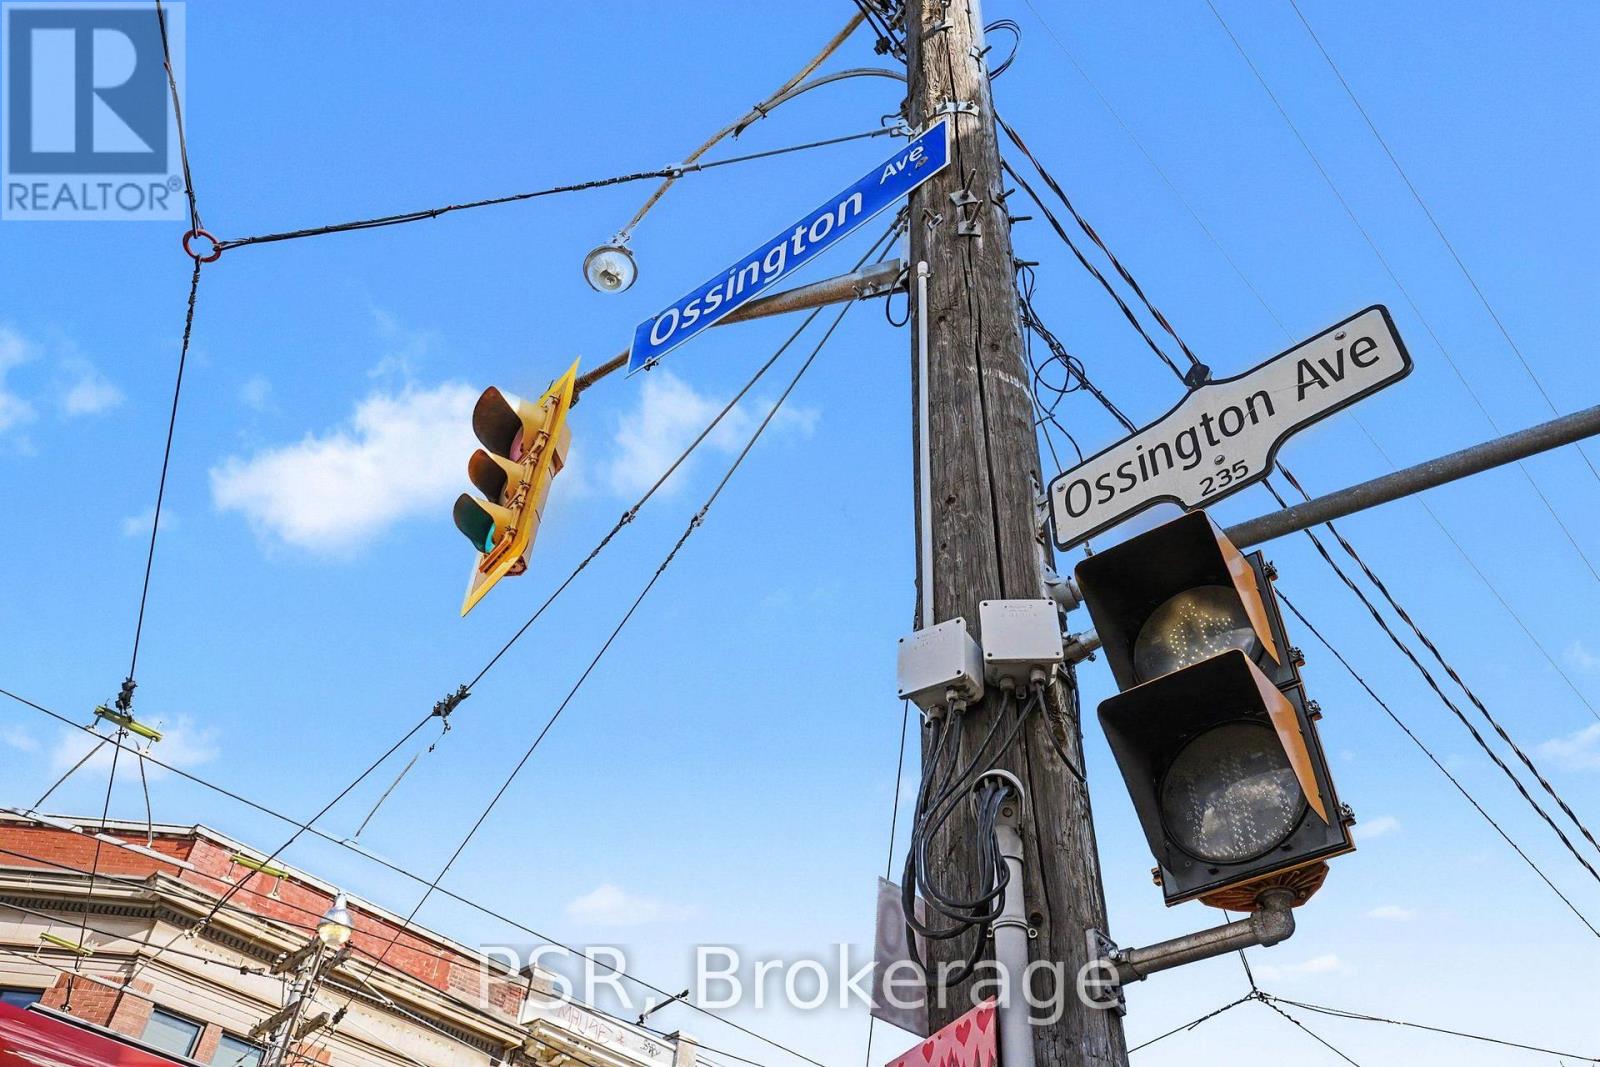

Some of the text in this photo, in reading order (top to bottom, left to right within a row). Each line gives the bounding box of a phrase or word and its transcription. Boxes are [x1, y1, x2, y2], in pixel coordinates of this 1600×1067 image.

[650, 146, 924, 346] Ossington Ave
[1064, 336, 1381, 518] Ossington Ave
[1199, 459, 1249, 497] 235
